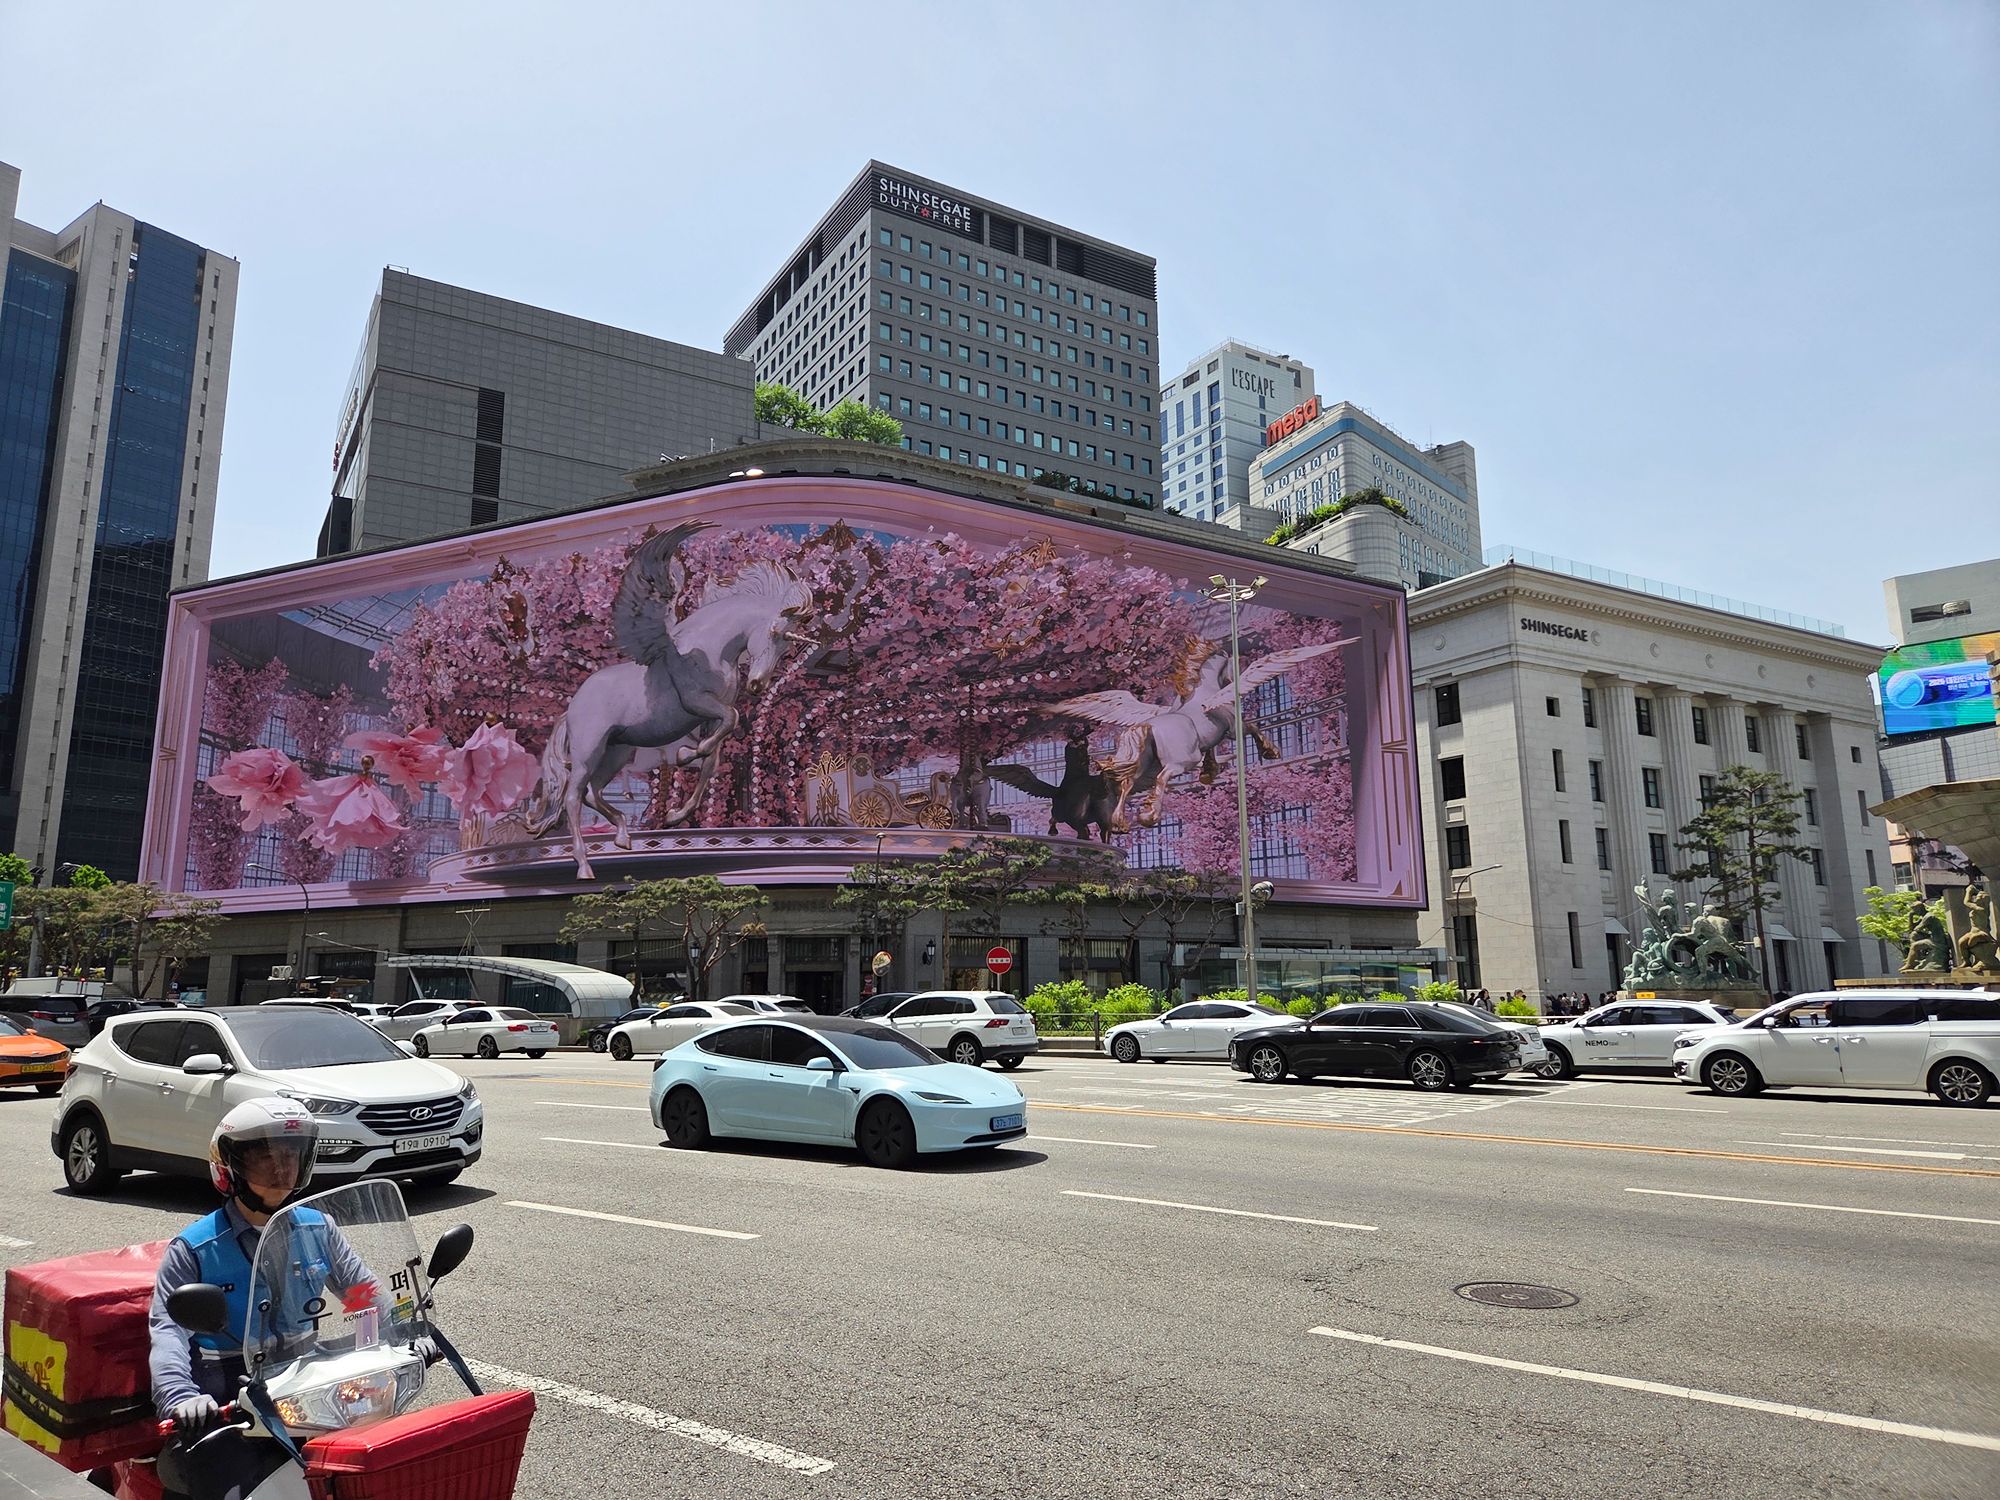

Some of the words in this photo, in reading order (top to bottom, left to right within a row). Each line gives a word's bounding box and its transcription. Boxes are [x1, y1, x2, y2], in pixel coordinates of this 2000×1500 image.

[880, 178, 971, 220] SHINSEGAE
[880, 193, 919, 214] DUTY
[932, 211, 971, 232] FREE
[1232, 367, 1275, 399] L'ESCAPE
[1266, 395, 1318, 447] mesa
[1520, 617, 1589, 642] SHINSEGAE
[423, 1135, 446, 1148] 0910
